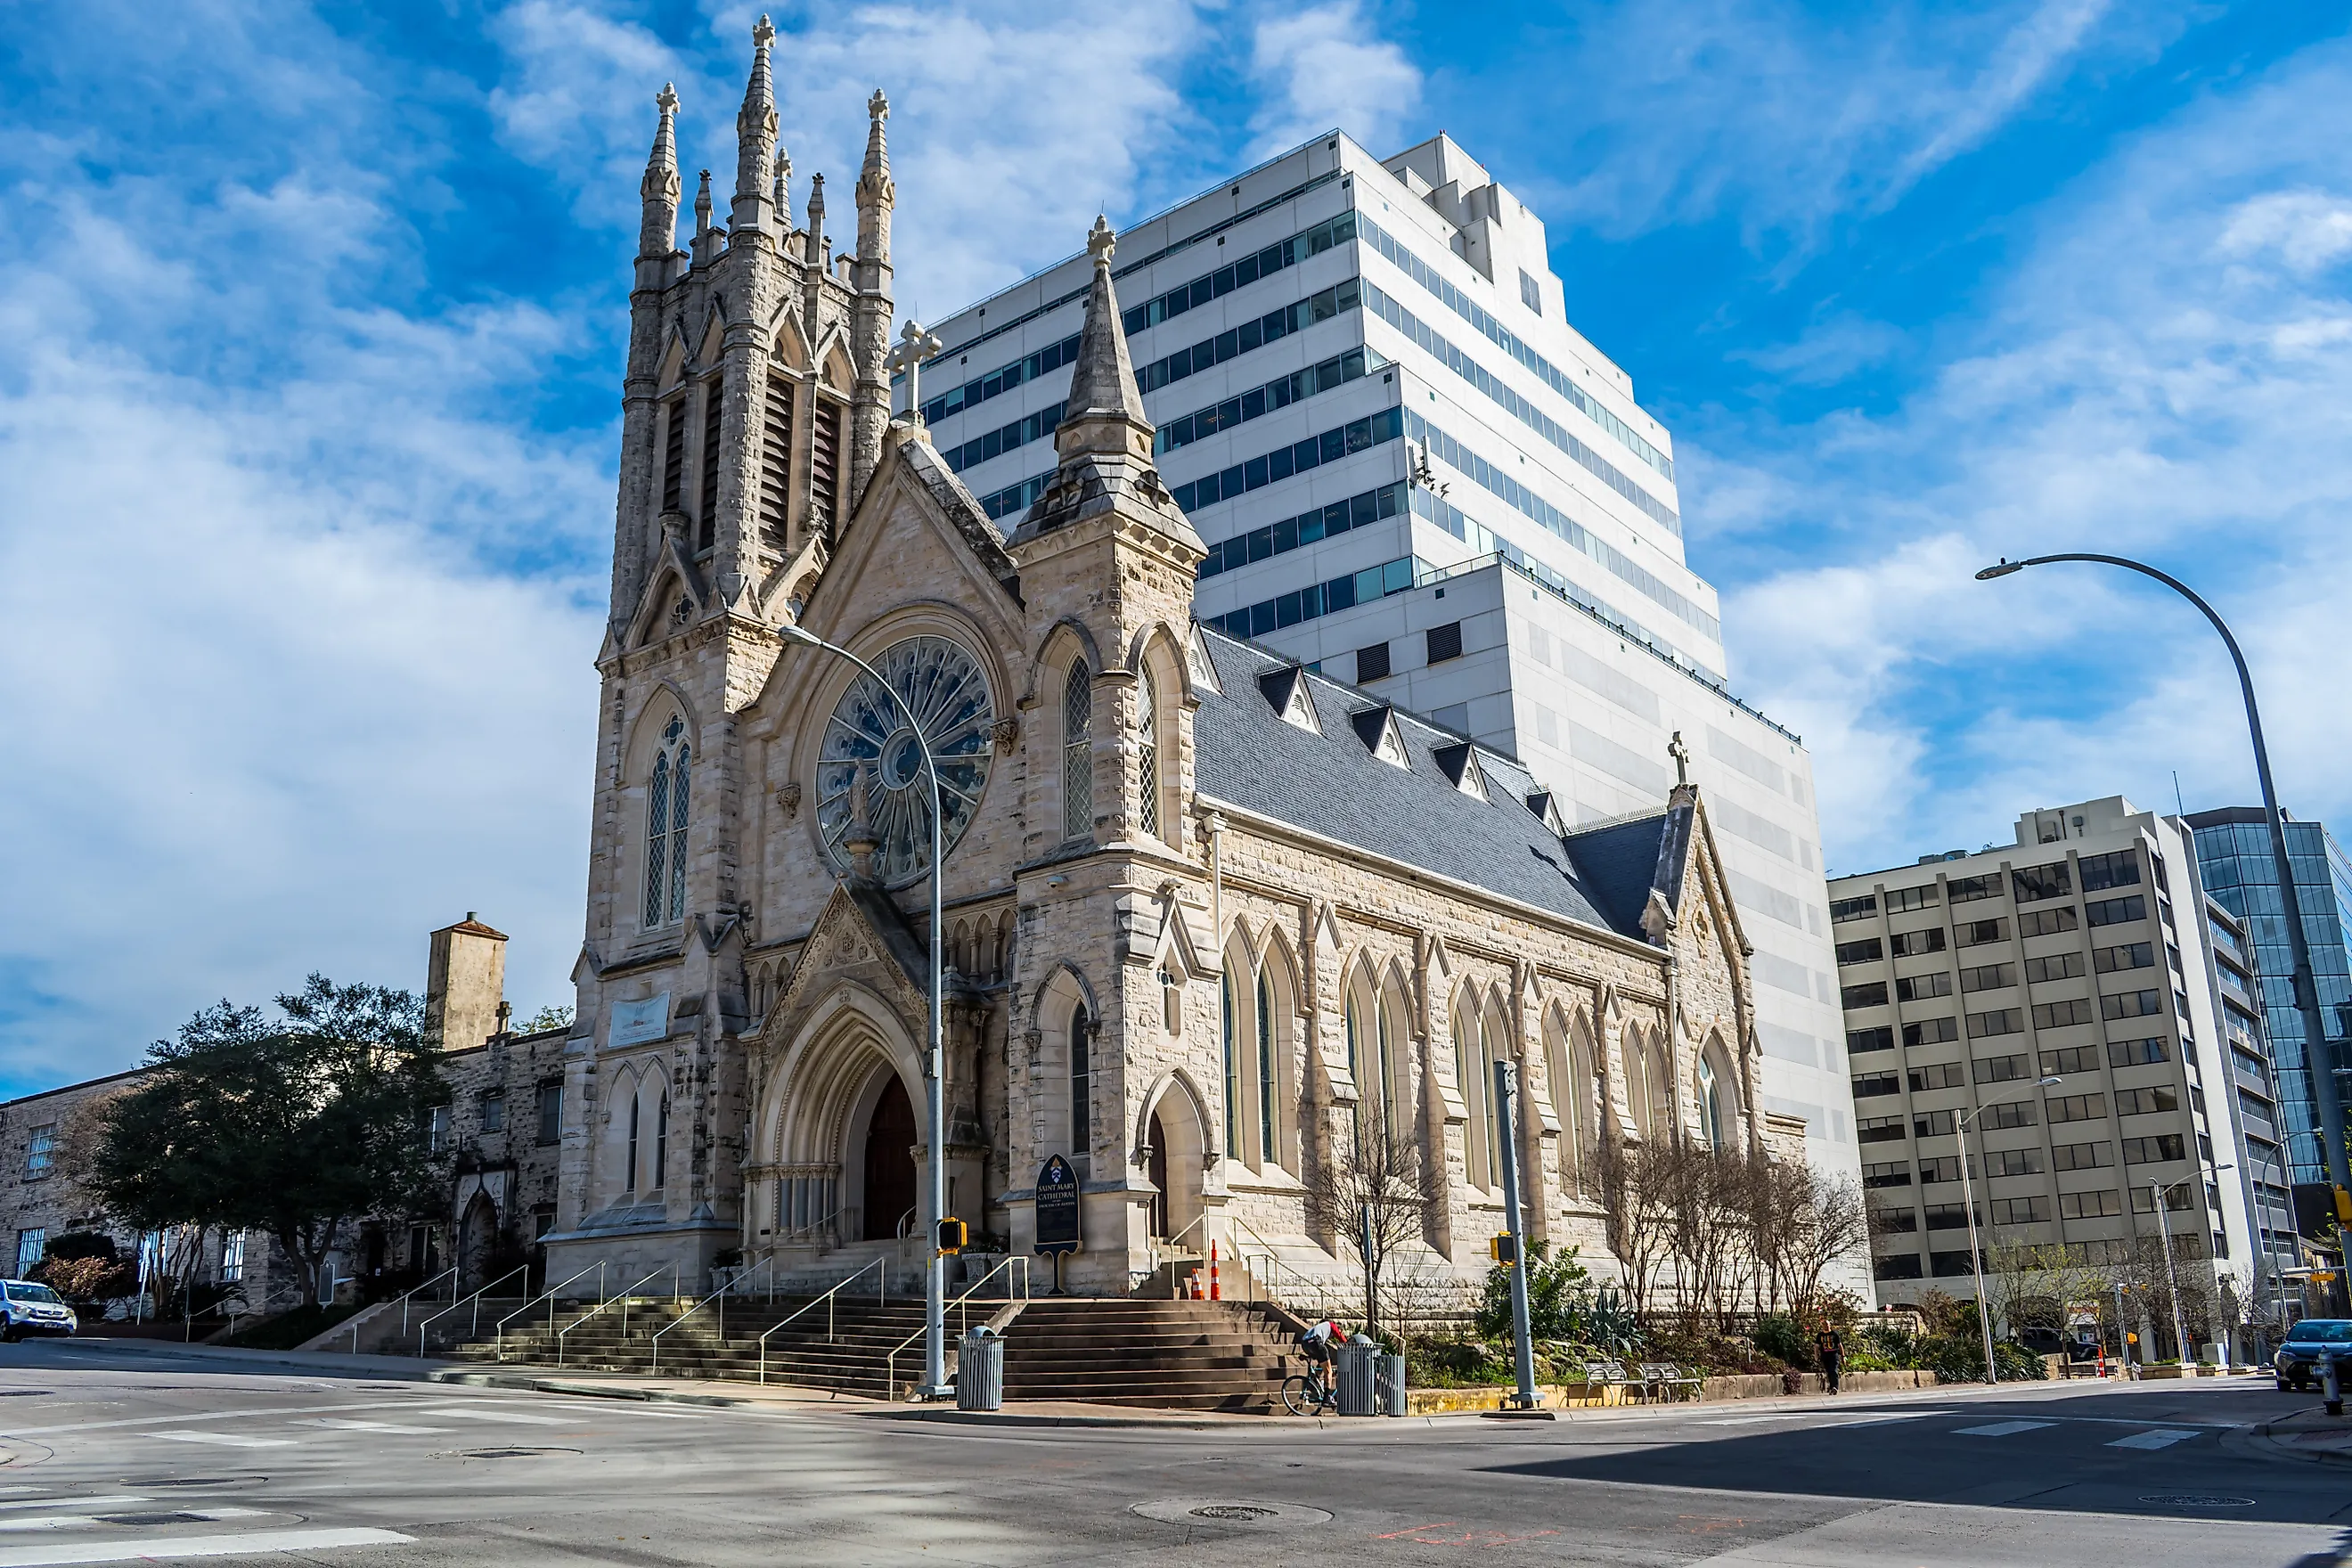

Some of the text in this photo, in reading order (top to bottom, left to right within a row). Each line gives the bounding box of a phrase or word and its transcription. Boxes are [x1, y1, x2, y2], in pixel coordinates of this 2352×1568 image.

[1038, 1182, 1075, 1192] SAINT MARY
[1037, 1191, 1075, 1201] CATHEDRAL
